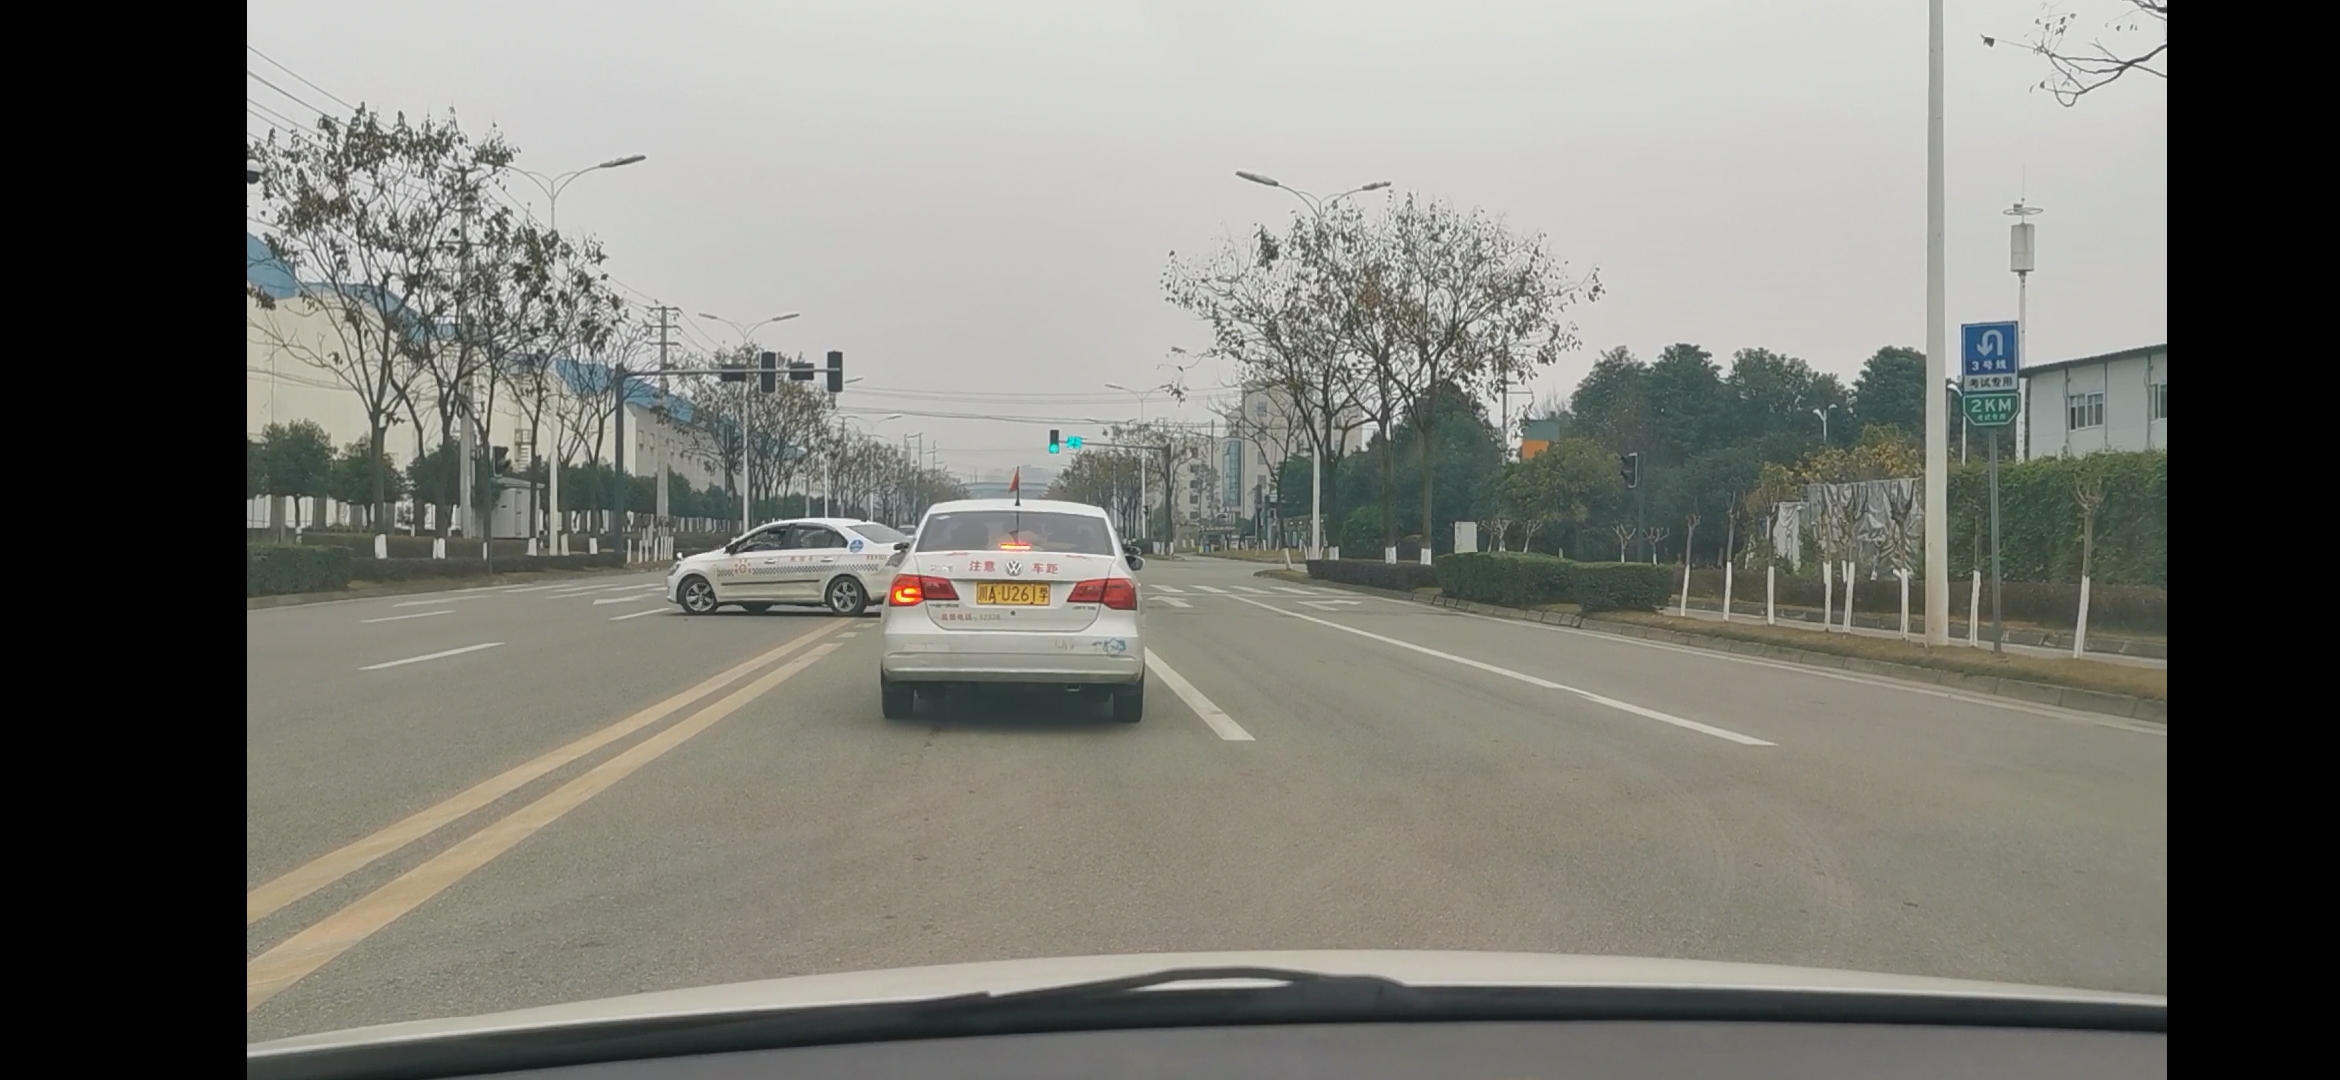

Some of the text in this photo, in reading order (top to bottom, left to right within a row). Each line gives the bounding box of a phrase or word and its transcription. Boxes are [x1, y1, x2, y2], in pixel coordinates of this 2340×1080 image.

[1972, 359, 2007, 371] 3号线
[1969, 376, 2013, 388] 考试专用
[1971, 398, 2012, 413] 2KM
[968, 560, 996, 572] 注意
[1031, 562, 1059, 574] 车距
